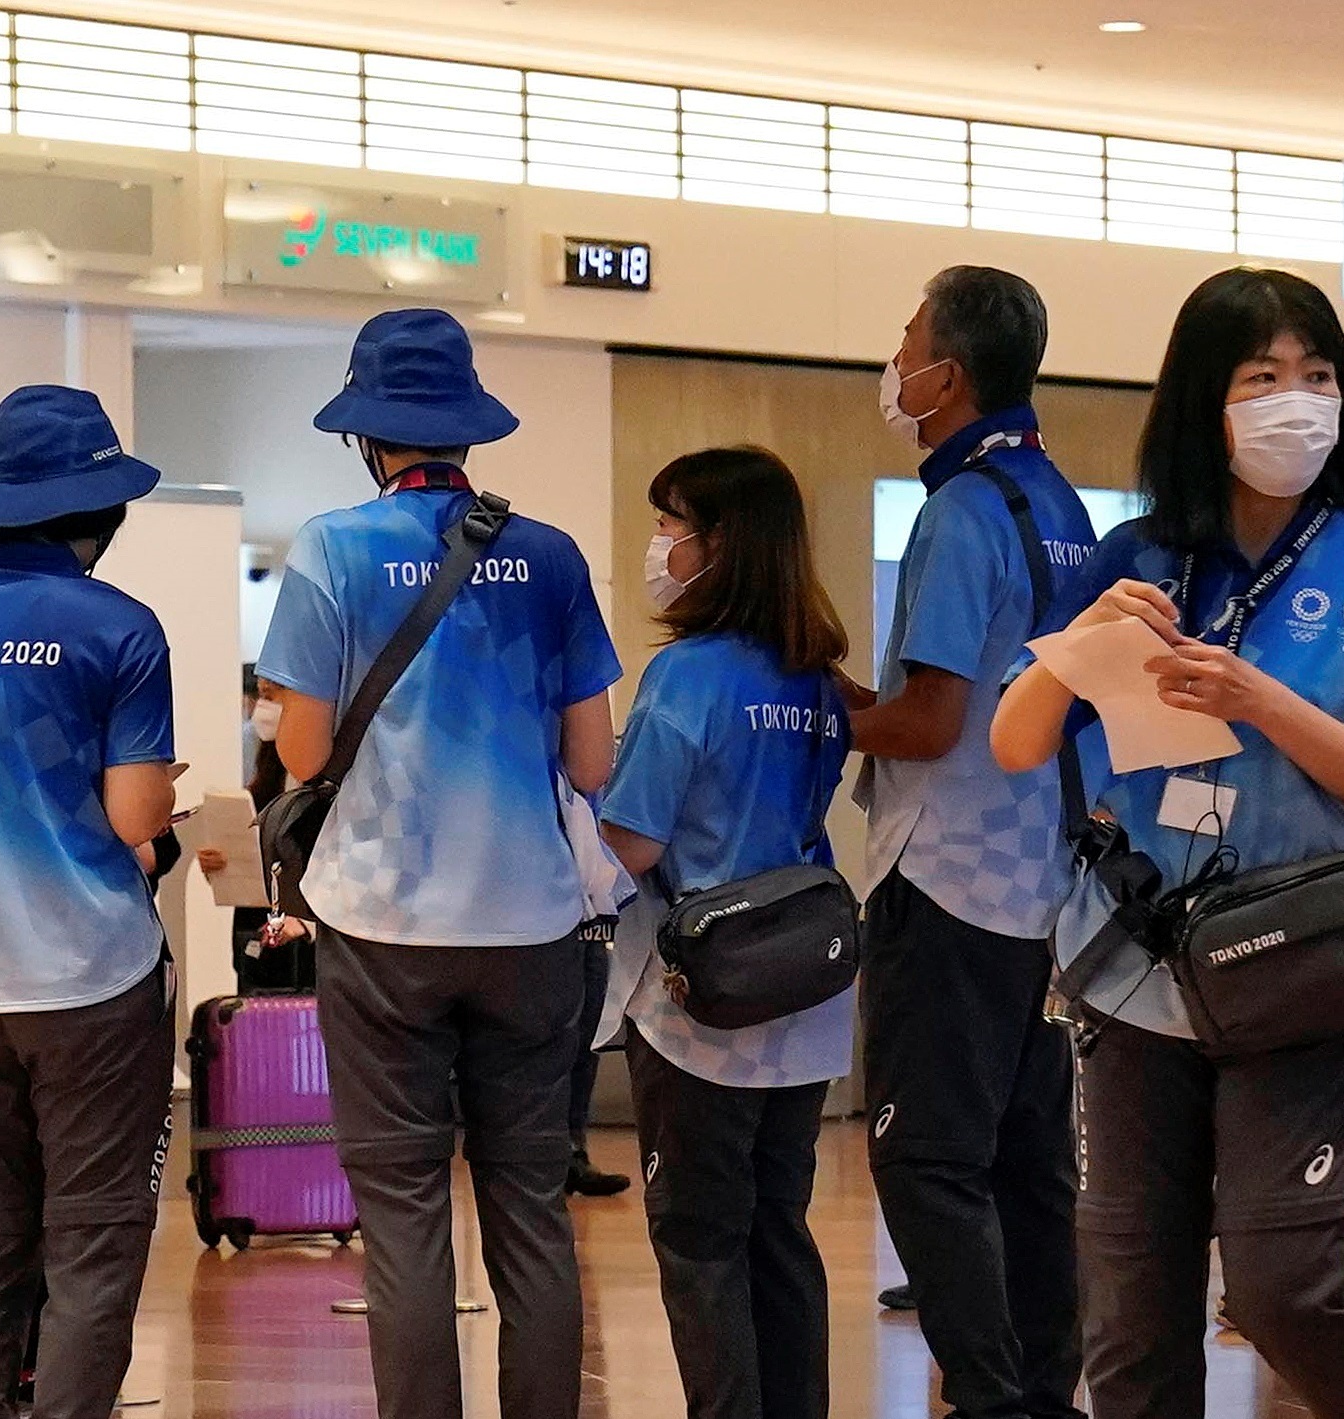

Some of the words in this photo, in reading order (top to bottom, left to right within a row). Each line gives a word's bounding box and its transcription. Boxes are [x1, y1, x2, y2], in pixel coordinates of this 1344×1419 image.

[334, 221, 412, 261] SEVEN
[577, 246, 648, 285] 14:18
[383, 562, 440, 588] TOK
[1269, 554, 1294, 577] 2020
[0, 641, 62, 666] 2020
[744, 703, 800, 732] TOKYO
[722, 900, 751, 915] 2020
[1208, 940, 1253, 964] TOKYO
[1252, 930, 1286, 951] 2020
